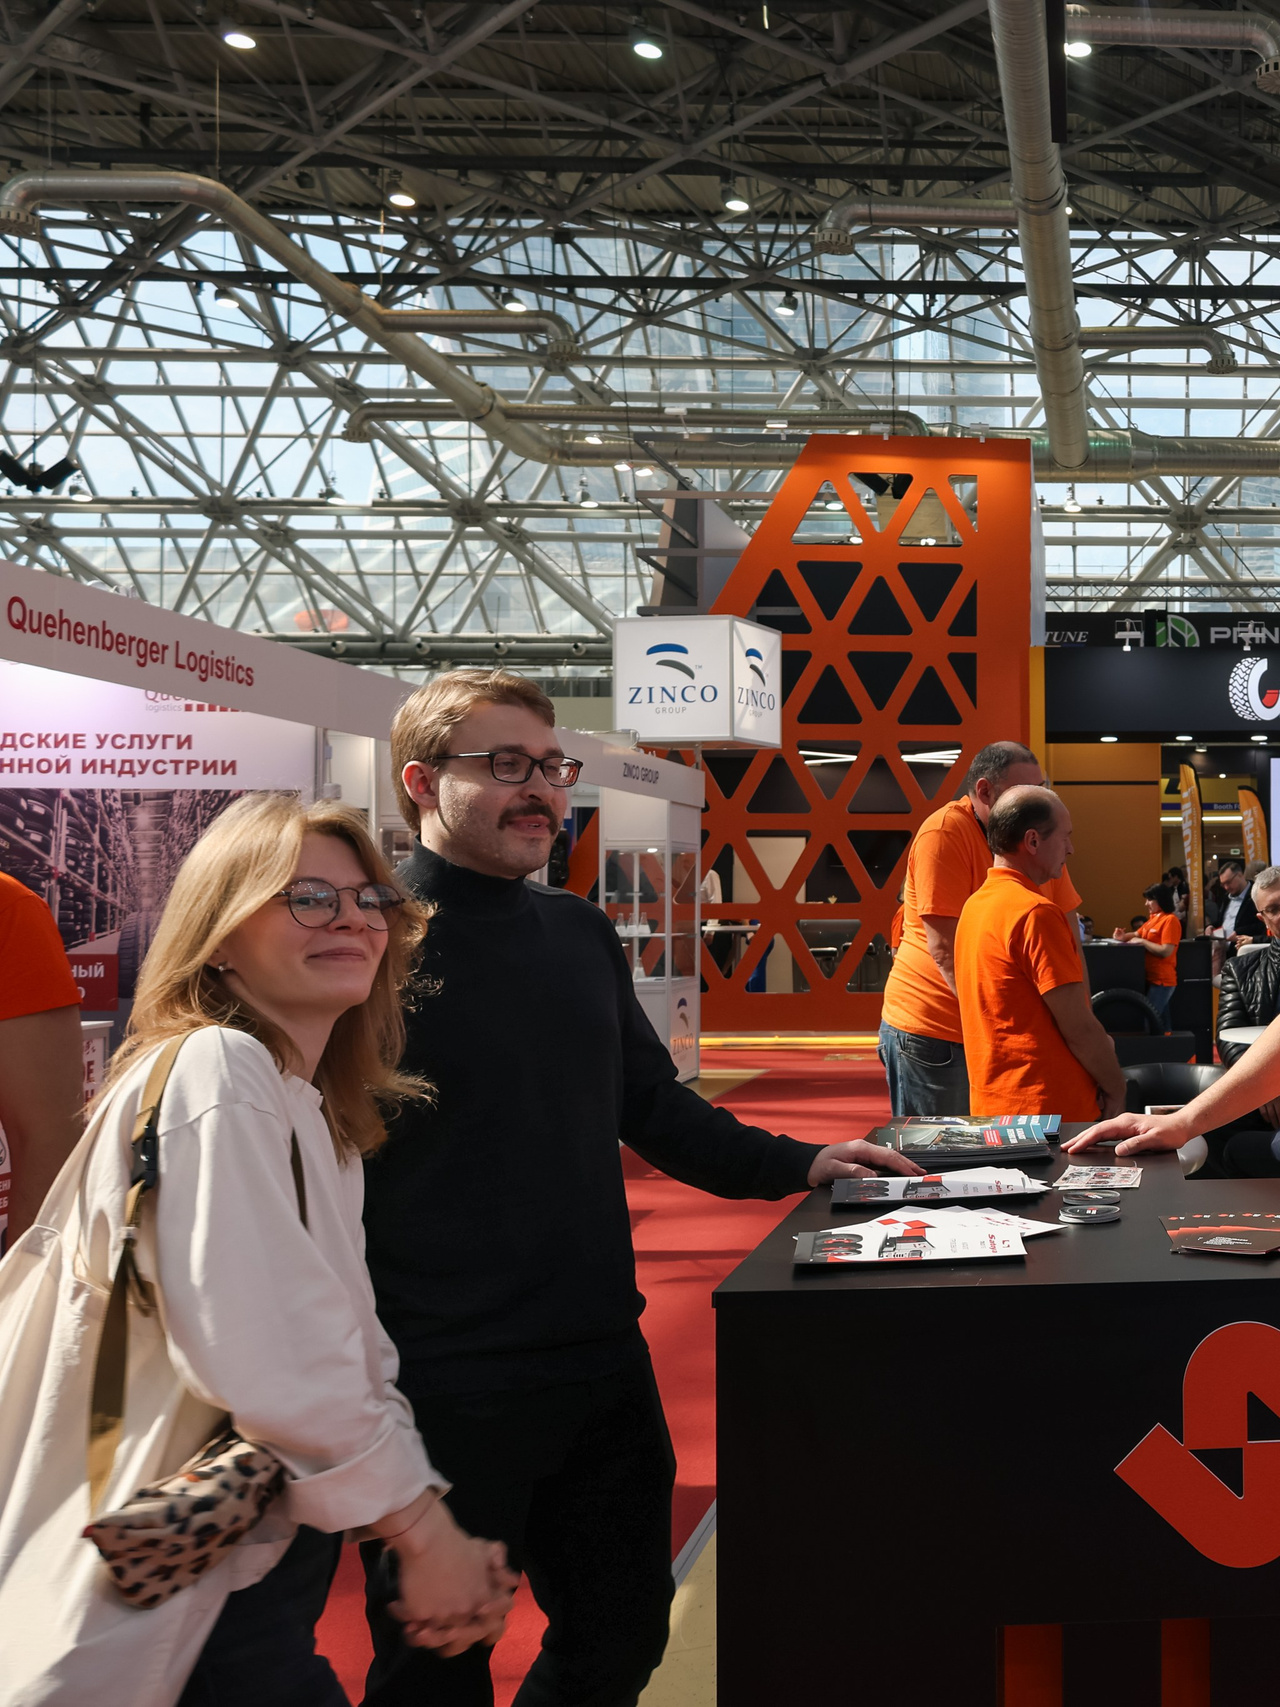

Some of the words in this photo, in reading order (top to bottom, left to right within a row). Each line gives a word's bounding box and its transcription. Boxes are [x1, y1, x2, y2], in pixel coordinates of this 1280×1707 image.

[7, 596, 169, 668] Quehenberger
[175, 640, 254, 687] Logistics
[628, 684, 718, 704] ZINCO
[737, 686, 776, 711] ZINCO
[655, 706, 687, 714] GROUP
[96, 734, 193, 750] УСЛУГИ
[81, 759, 237, 777] ИНДУСТРИИ
[622, 762, 640, 780] ZINCO
[640, 767, 660, 784] GROUP
[673, 1033, 694, 1055] ZINCO
